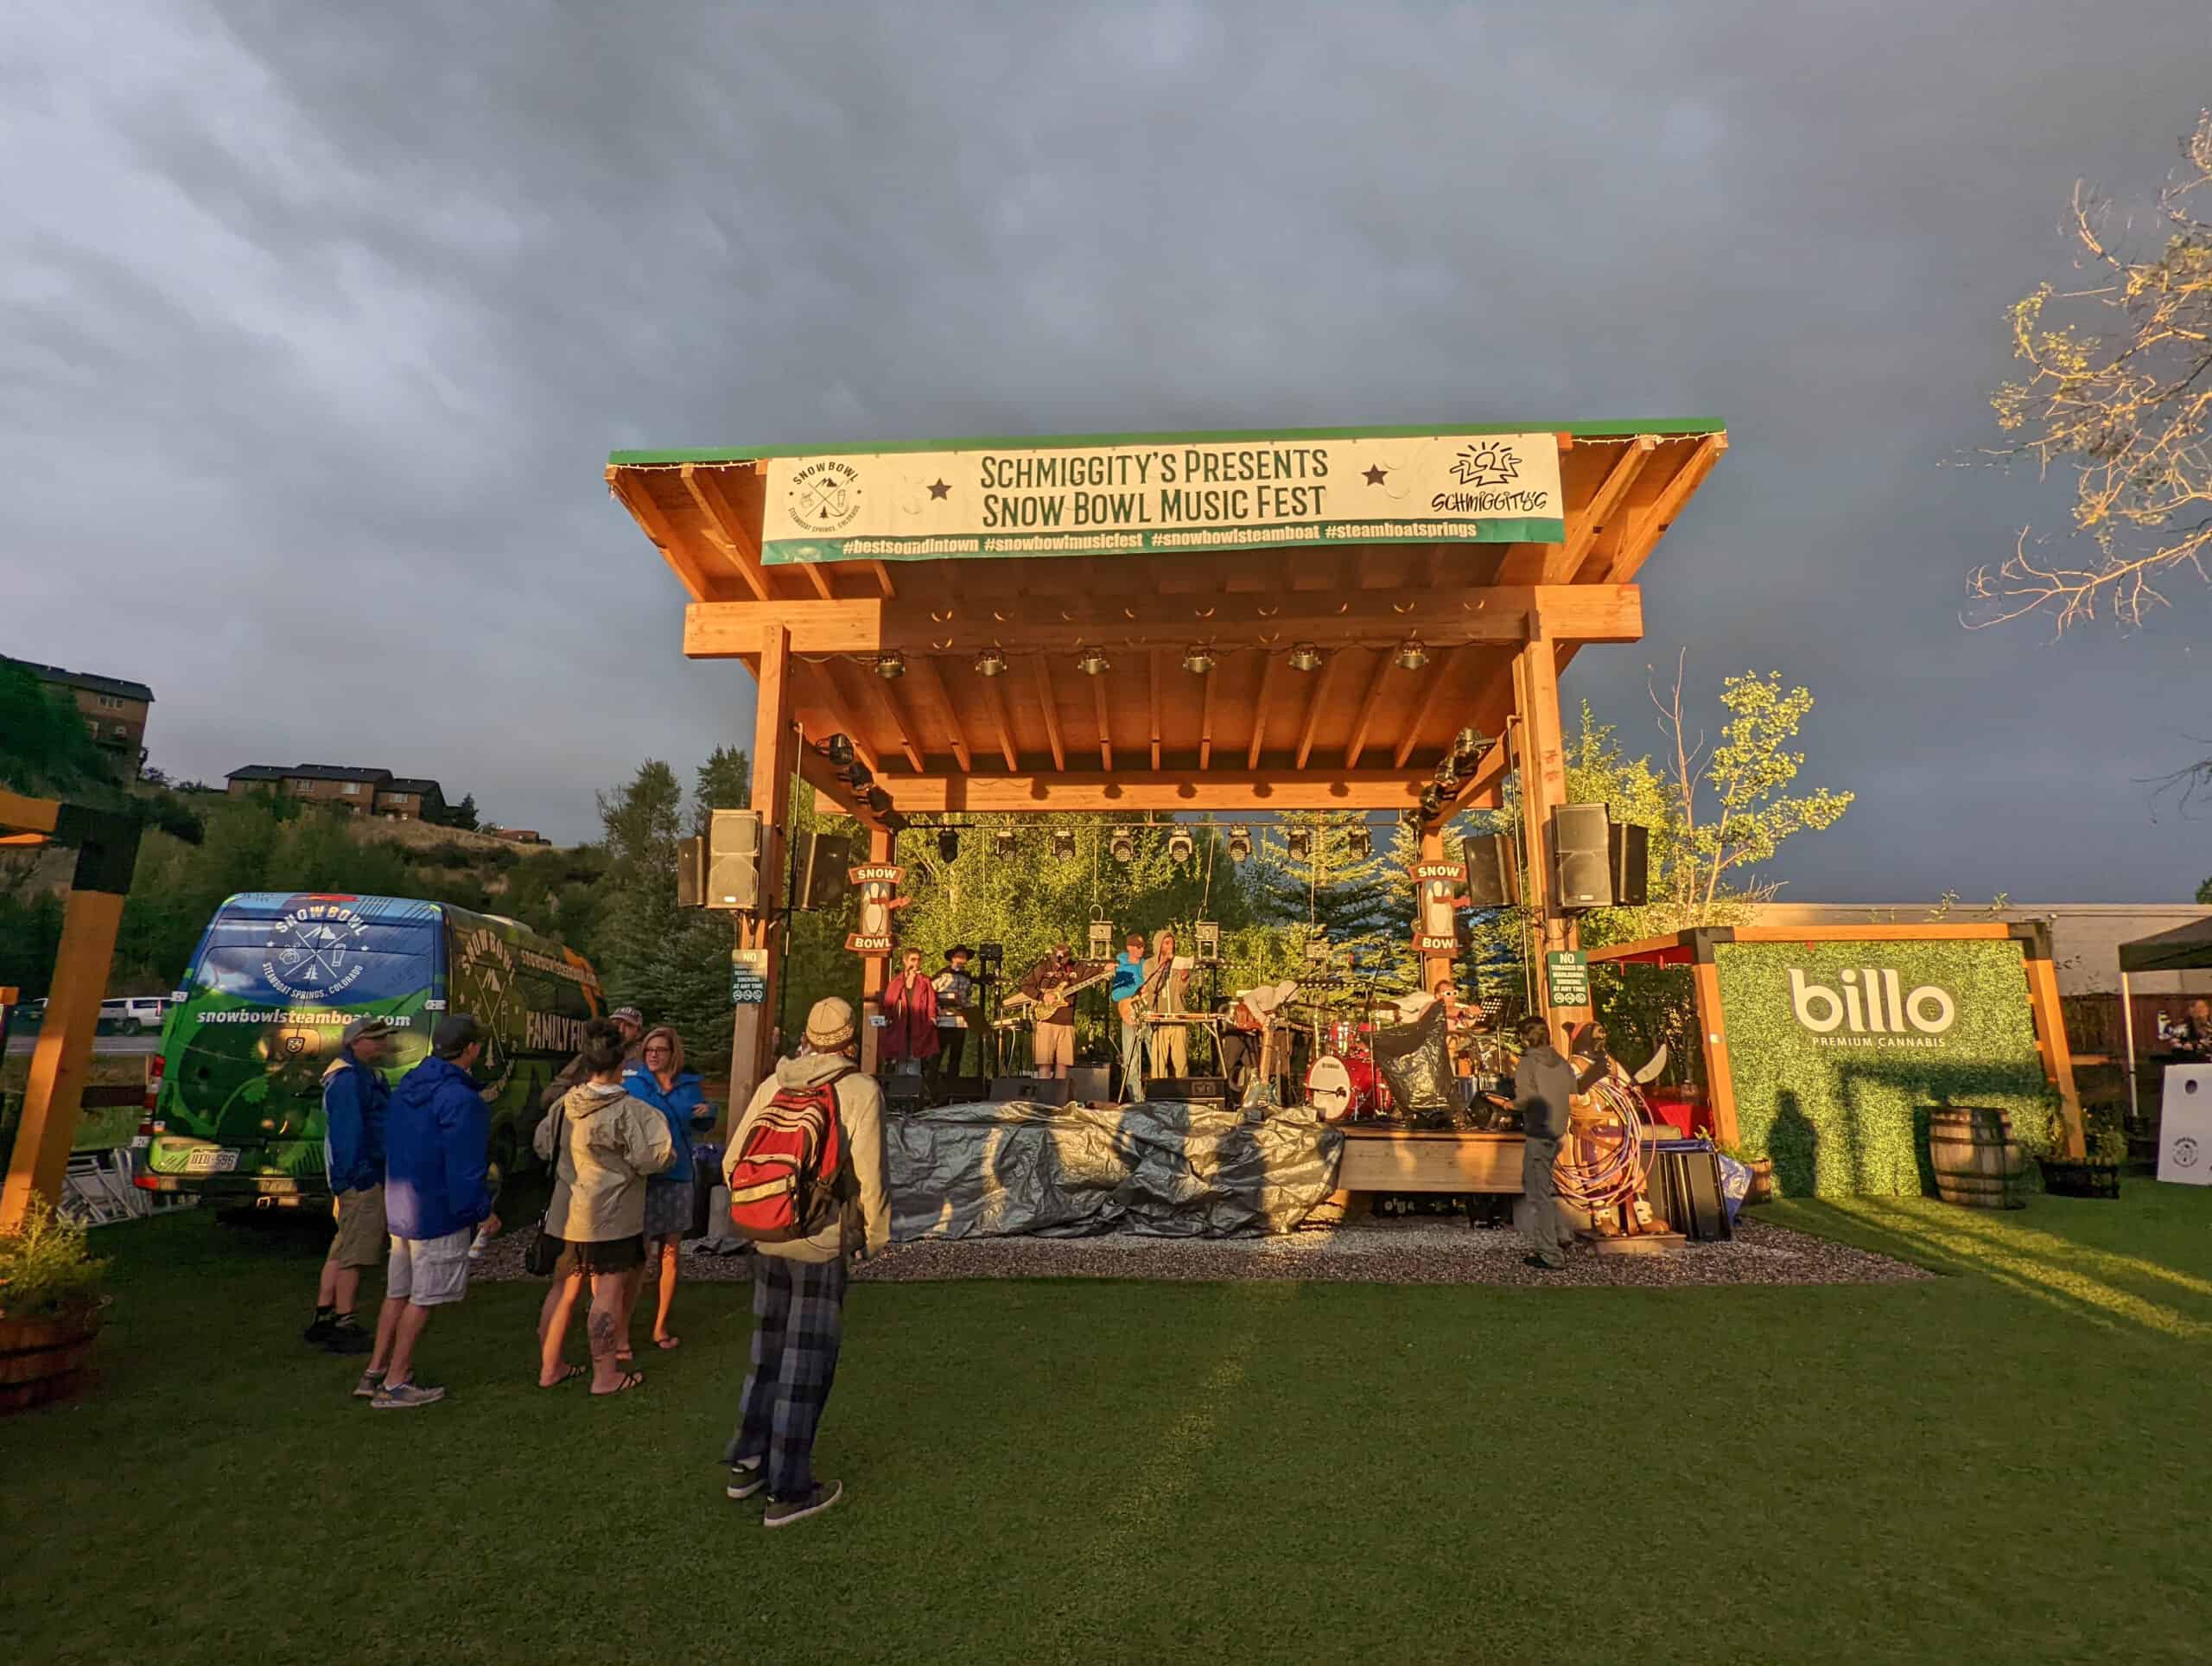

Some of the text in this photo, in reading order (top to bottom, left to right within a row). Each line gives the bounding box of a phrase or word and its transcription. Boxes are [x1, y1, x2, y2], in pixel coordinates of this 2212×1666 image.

[981, 449, 1329, 489] SCHMIGGITY'S PRESENTS
[982, 485, 1327, 528] SNOW BOWL MUSIC FEST
[842, 522, 1478, 555] #bestsoundintown #snowbowlmusicfest #snowbowlsteamboat #steamboatsprings
[857, 868, 897, 879] SNOW
[1418, 866, 1460, 877] SNOW
[855, 937, 893, 949] BOWL
[743, 952, 757, 963] NO
[1560, 953, 1574, 963] NO
[262, 961, 291, 995] STEAMBOAT
[329, 964, 364, 994] COLORADO
[1788, 969, 1955, 1033] billo
[525, 1011, 569, 1052] FAMILY
[1812, 1037, 1946, 1047] PREMIUM CANNABIS
